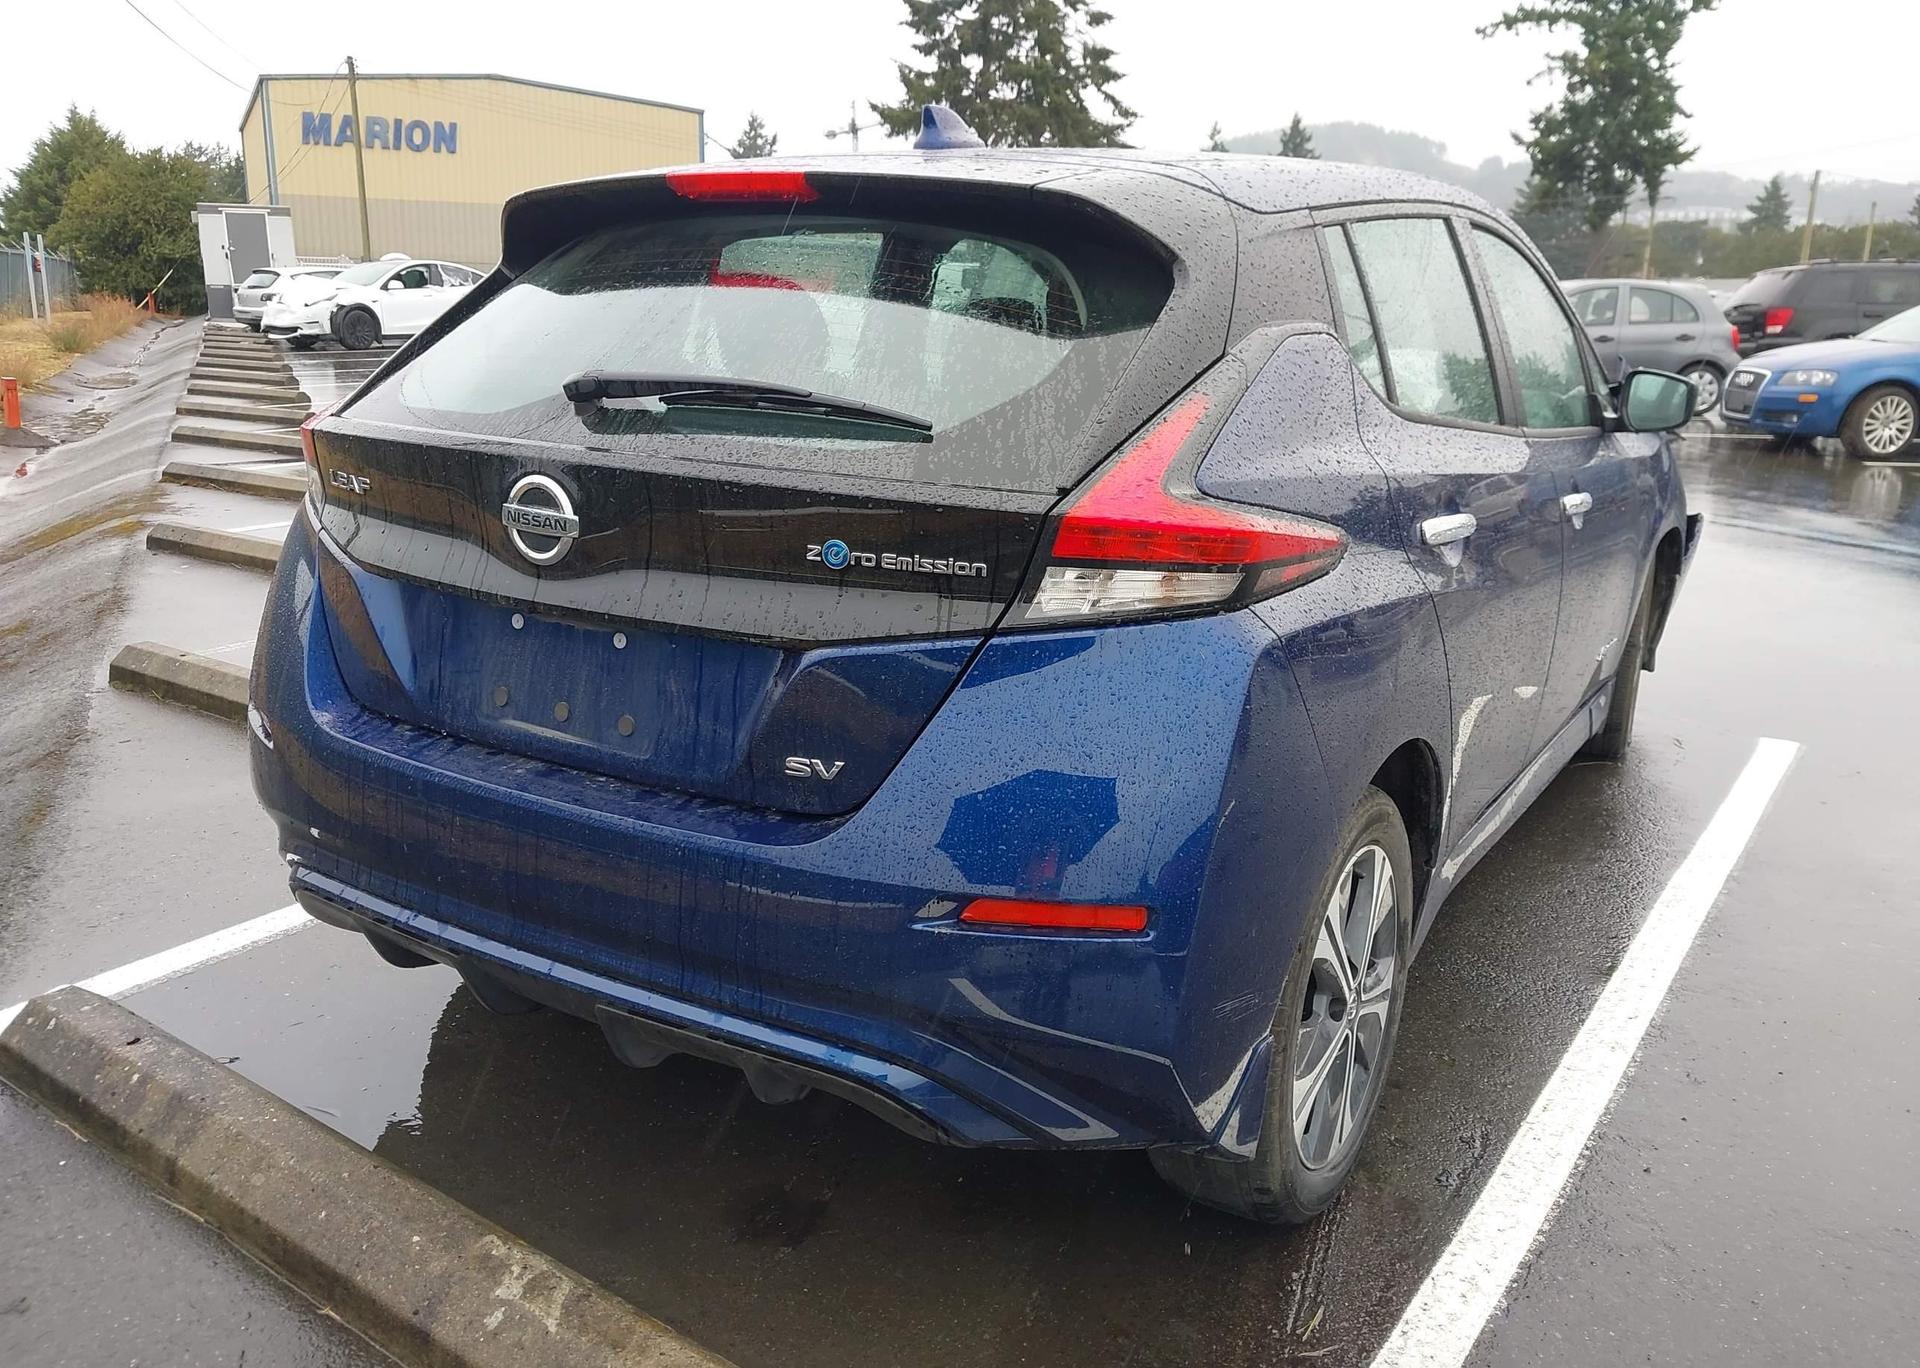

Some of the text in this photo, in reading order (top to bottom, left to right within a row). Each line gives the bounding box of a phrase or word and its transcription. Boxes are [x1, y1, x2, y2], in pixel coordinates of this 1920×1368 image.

[302, 111, 457, 153] MARION
[507, 510, 567, 532] NISSAN
[881, 553, 987, 578] Emission
[785, 757, 845, 780] SV
